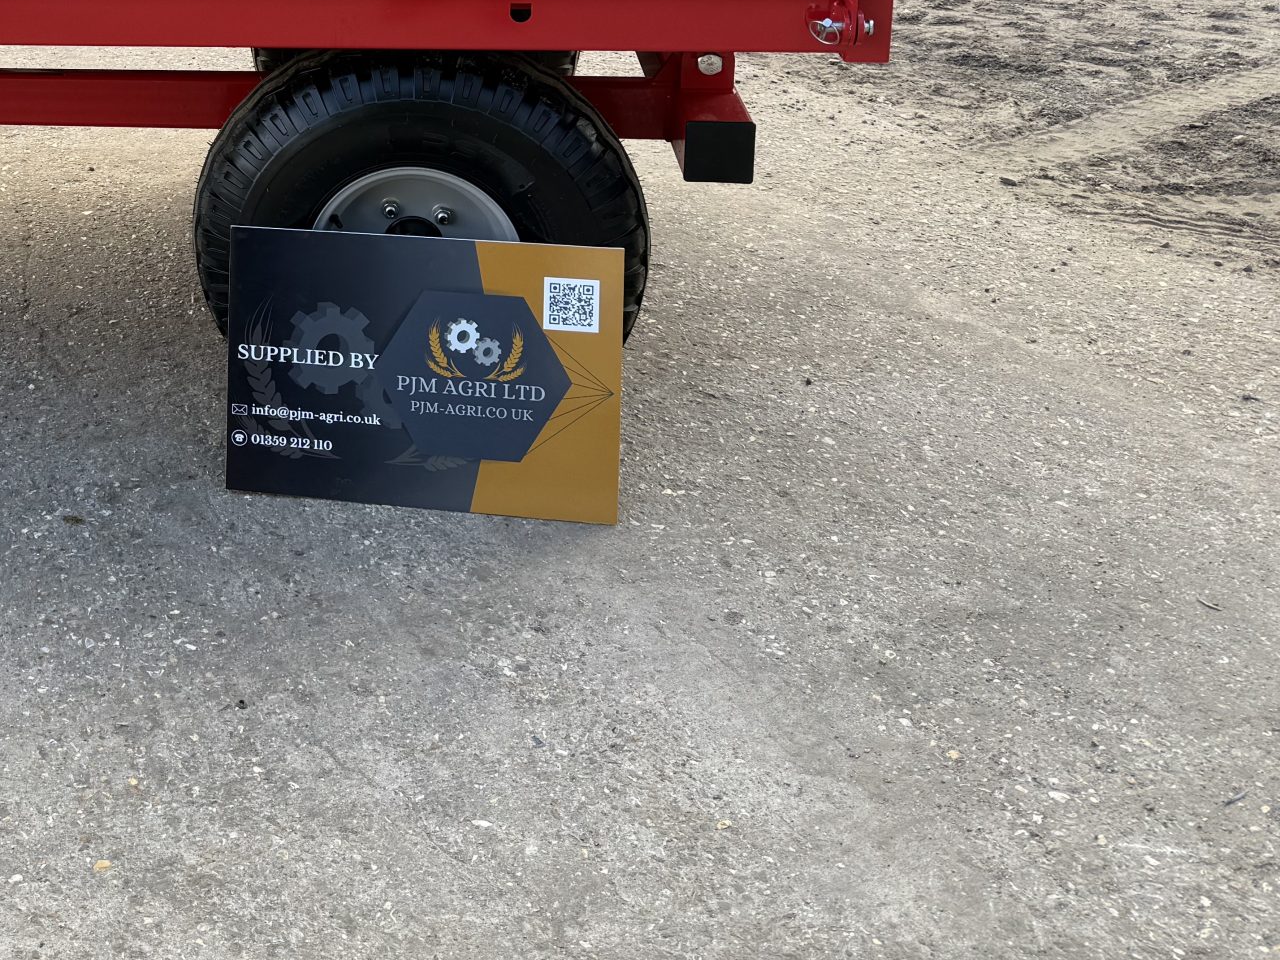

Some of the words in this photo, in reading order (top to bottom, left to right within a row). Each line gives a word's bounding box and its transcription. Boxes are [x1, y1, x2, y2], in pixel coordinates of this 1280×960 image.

[237, 344, 344, 367] SUPPLIED
[349, 352, 379, 370] BY
[396, 375, 438, 396] PJM
[443, 379, 497, 398] AGRI
[502, 383, 546, 402] LTD
[251, 404, 381, 426] info@pjm-agri.co.uk
[251, 433, 287, 447] 01359
[289, 437, 311, 449] 212
[313, 439, 333, 451] 110
